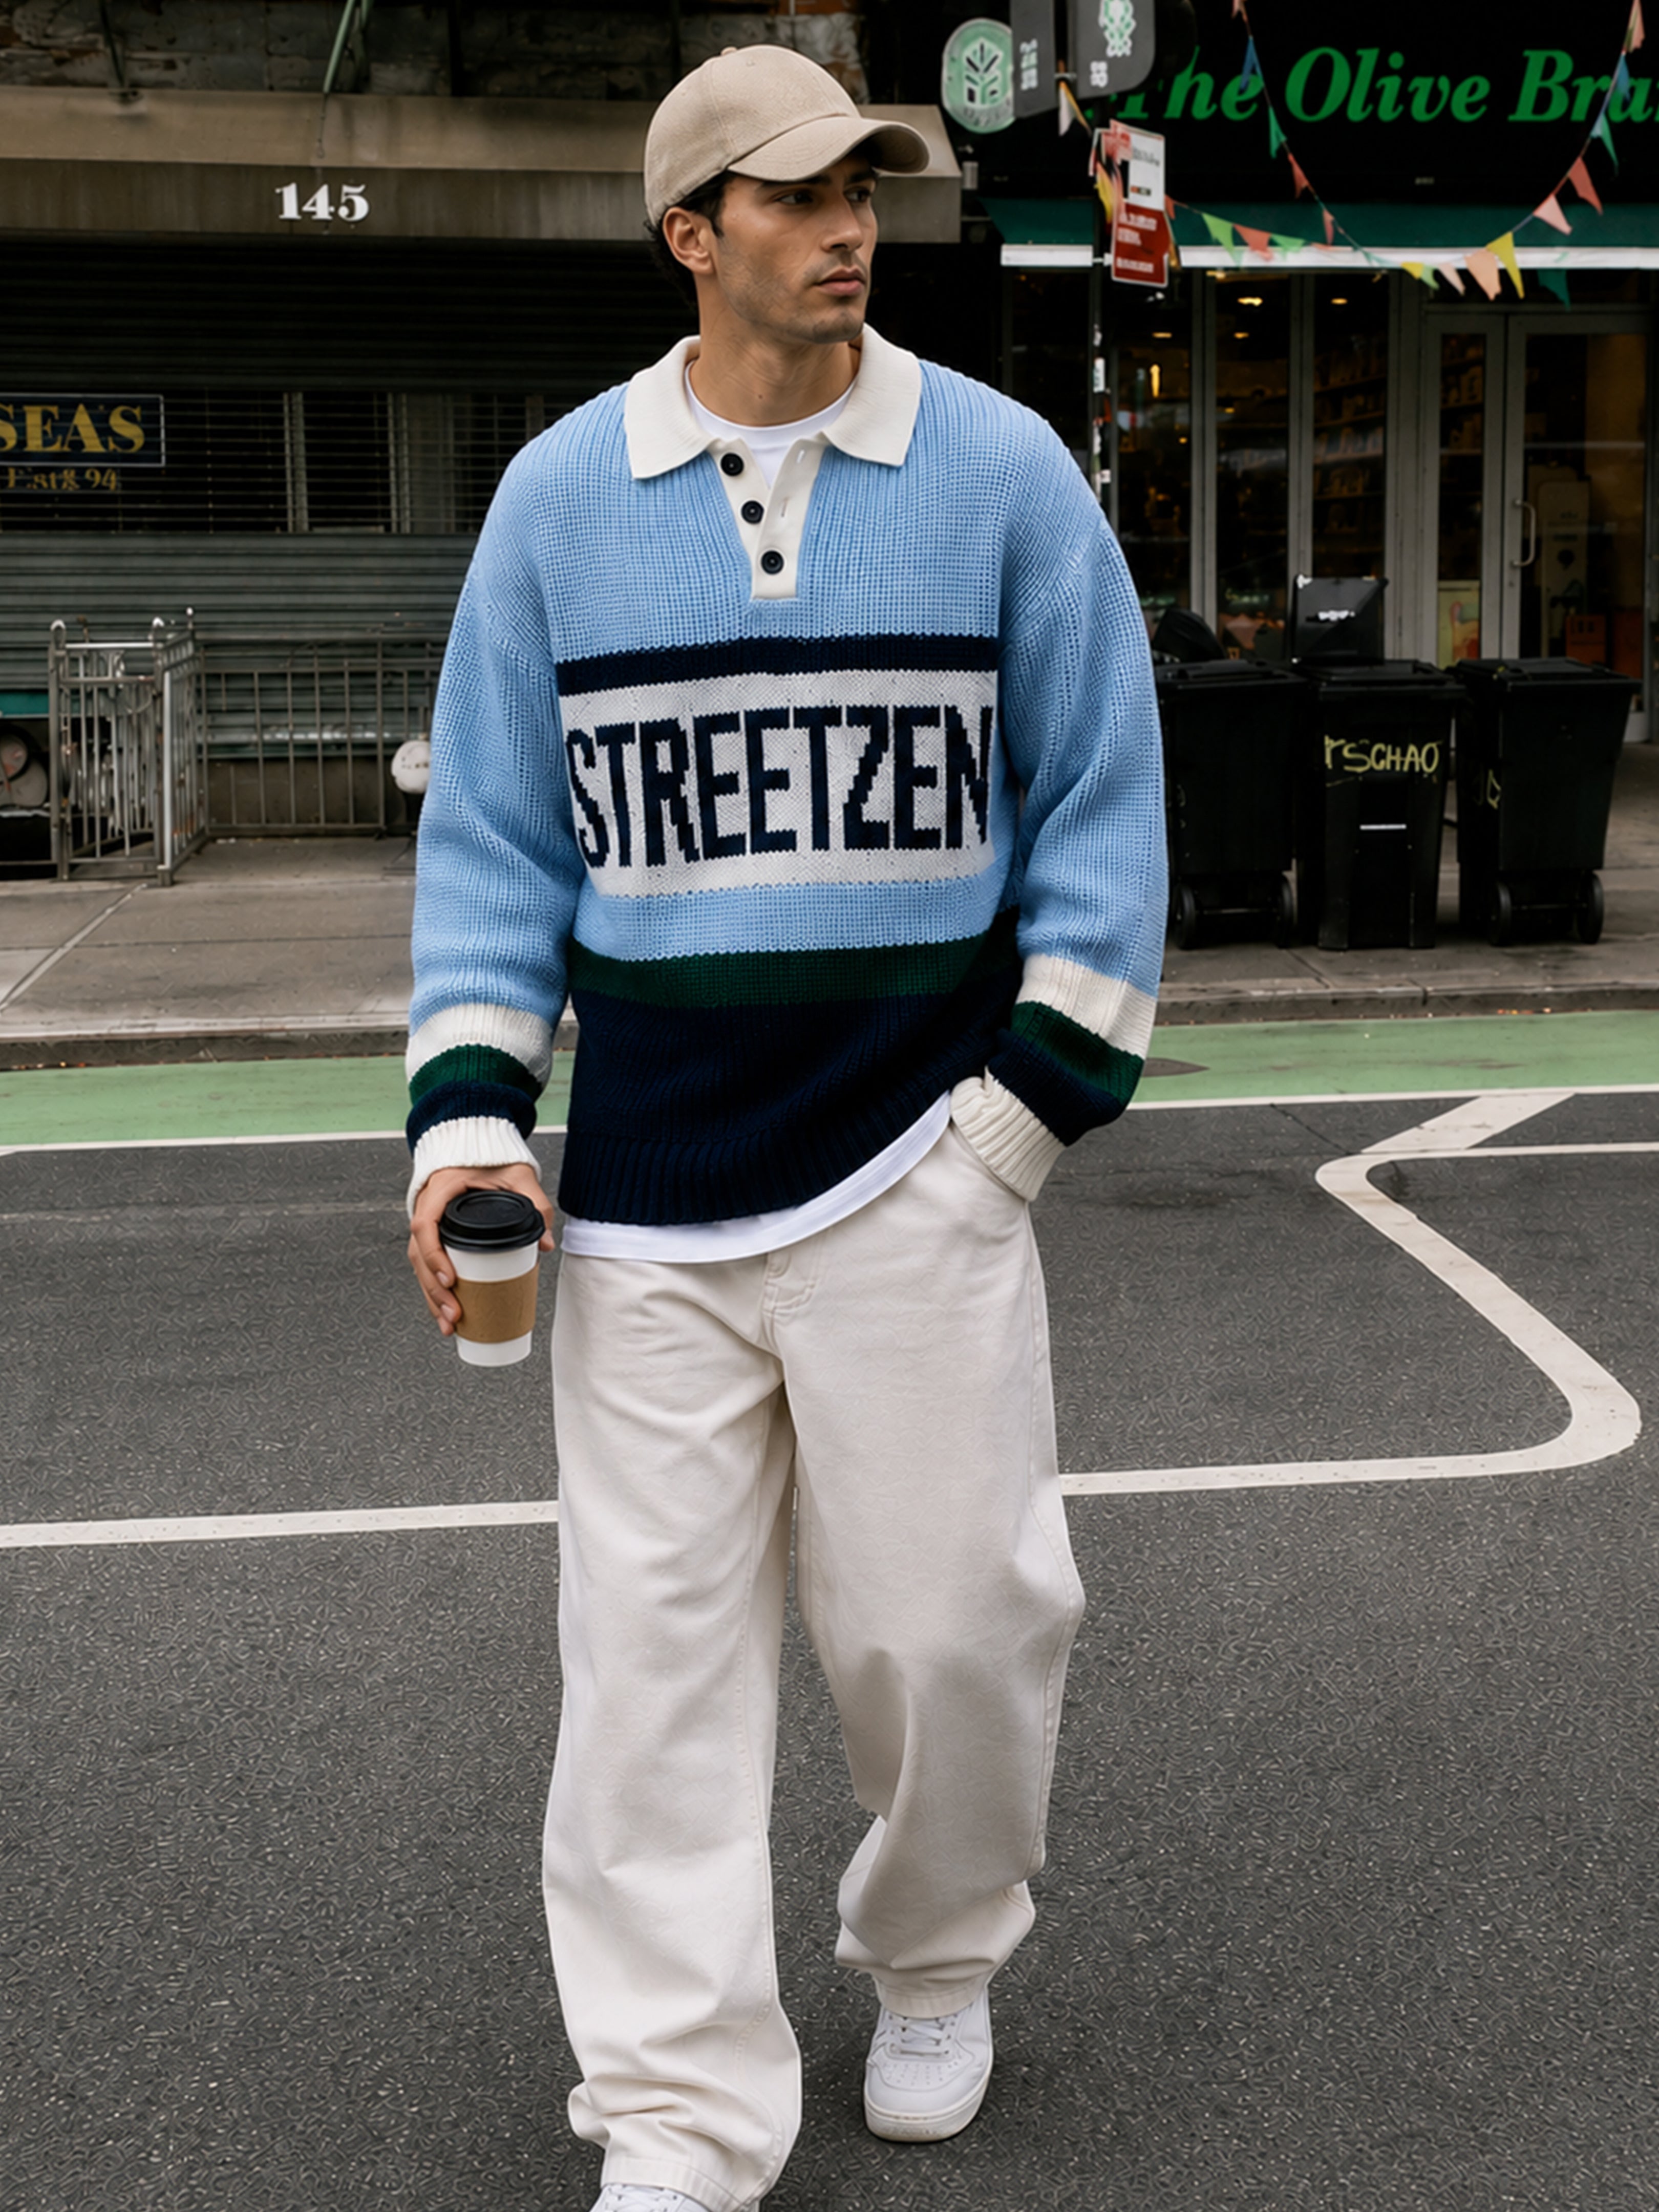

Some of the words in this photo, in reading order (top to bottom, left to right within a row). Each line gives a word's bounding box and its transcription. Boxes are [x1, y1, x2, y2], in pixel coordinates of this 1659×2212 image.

[1285, 47, 1490, 122] Olive
[1507, 49, 1659, 123] Bra
[275, 182, 369, 222] 145
[565, 705, 992, 867] STREETZEN
